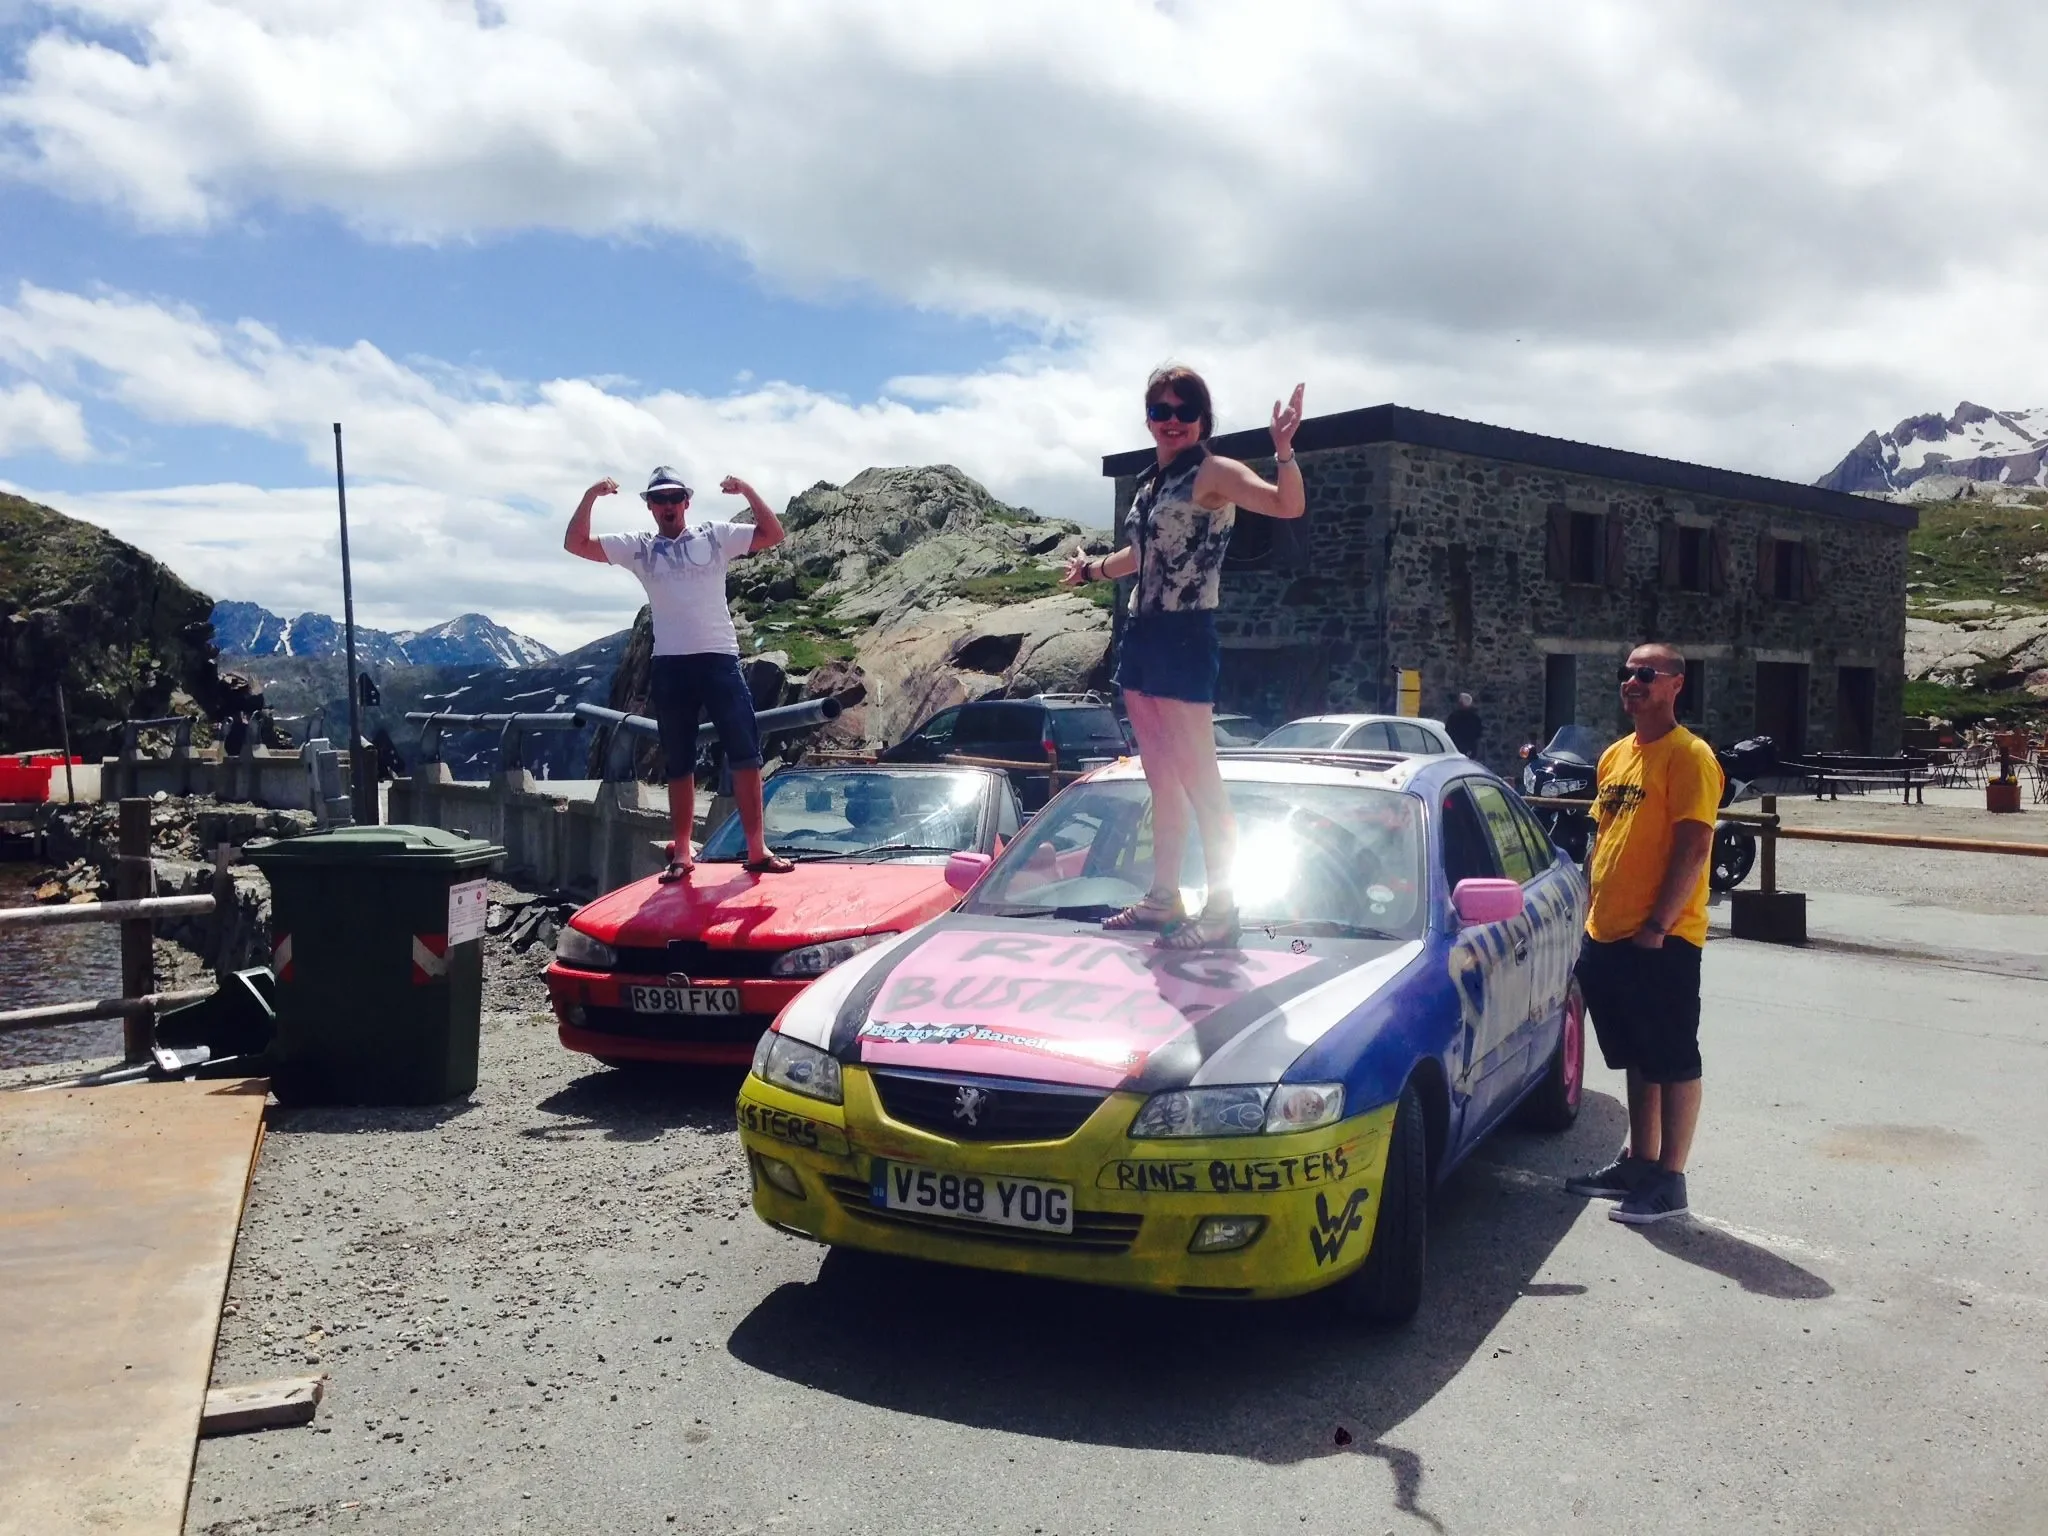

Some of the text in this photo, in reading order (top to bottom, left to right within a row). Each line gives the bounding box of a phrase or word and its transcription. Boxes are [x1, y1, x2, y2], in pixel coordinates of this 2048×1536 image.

[958, 936, 1267, 988] RING
[634, 988, 737, 1012] R981 FKO
[870, 1024, 938, 1041] Barmy
[944, 1026, 971, 1040] To
[1116, 1147, 1349, 1194] RING BUSTERS
[894, 1167, 1067, 1225] V588 YOG
